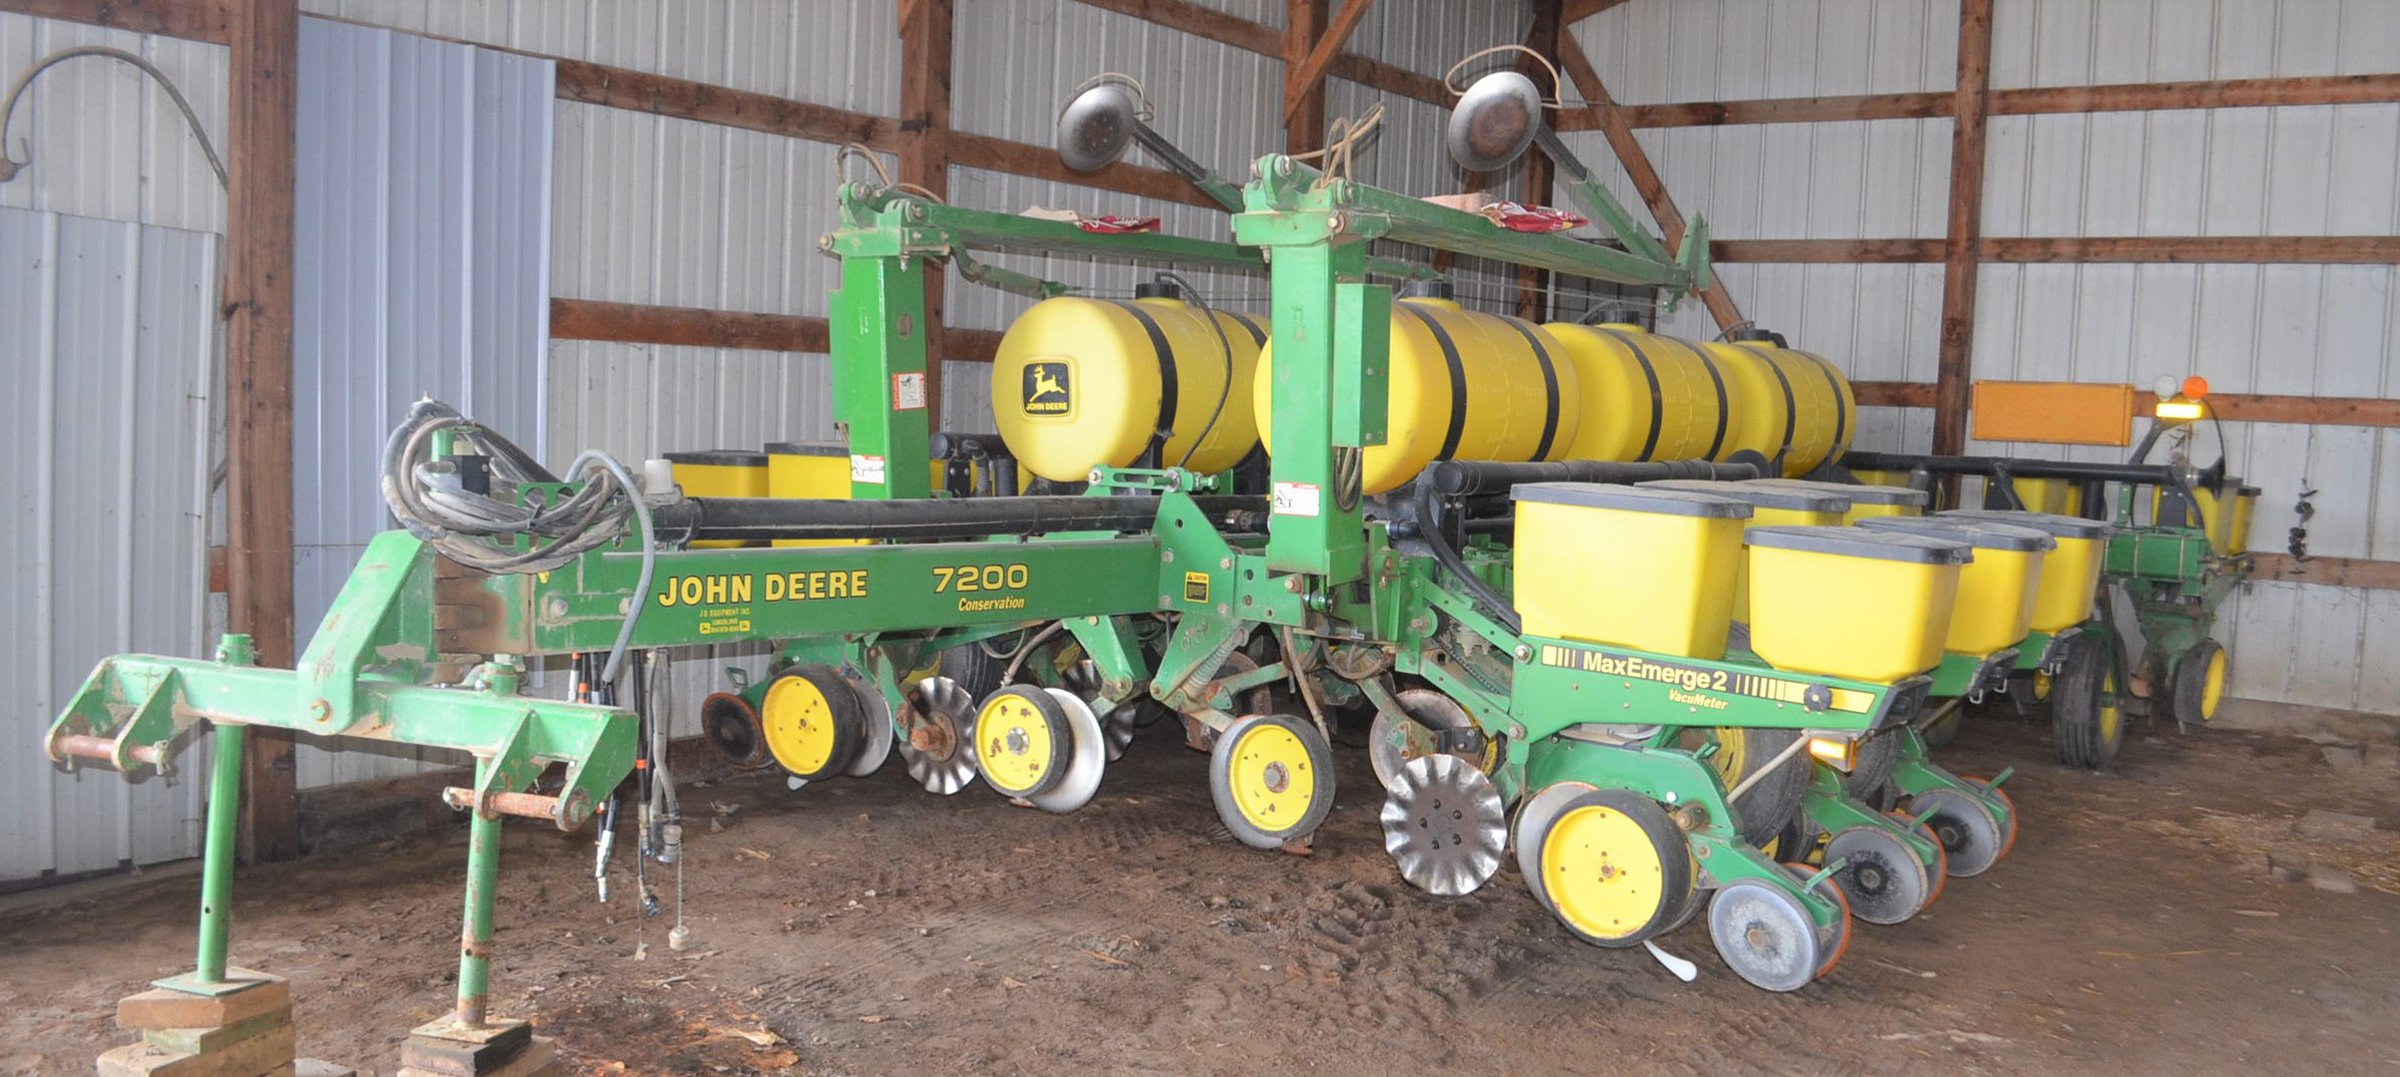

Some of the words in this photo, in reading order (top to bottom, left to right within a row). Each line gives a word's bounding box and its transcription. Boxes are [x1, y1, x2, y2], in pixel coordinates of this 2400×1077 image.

[1025, 402, 1044, 411] JOHN
[1045, 402, 1068, 411] DEERE
[658, 573, 752, 607] JOHN
[764, 569, 869, 602] DEERE
[932, 563, 1029, 594] 7200
[958, 596, 1025, 612] Conservation
[1583, 650, 1711, 691] MaxEmerge
[1712, 670, 1728, 692] 2
[1669, 688, 1729, 710] VacuMeter
